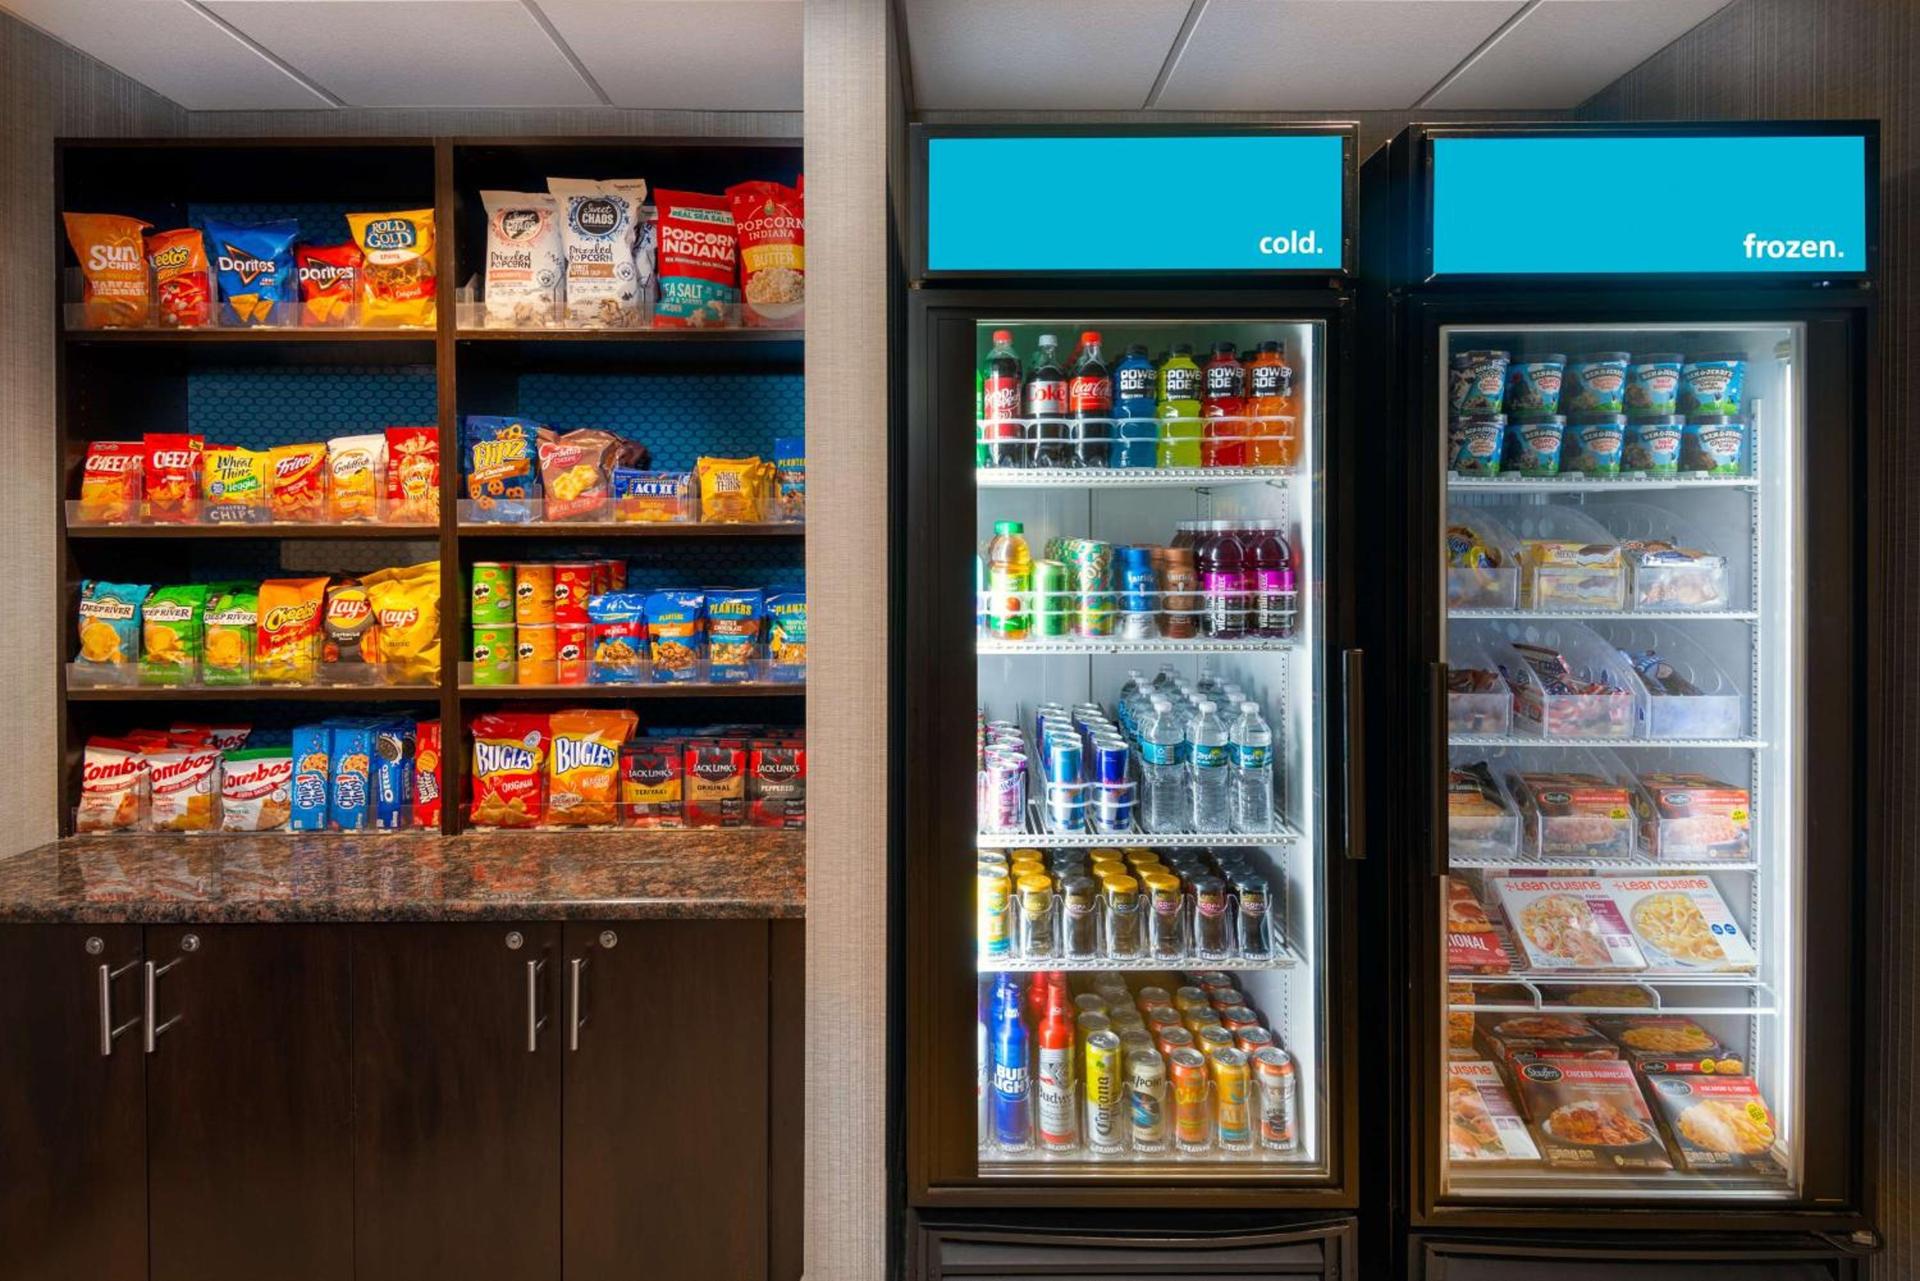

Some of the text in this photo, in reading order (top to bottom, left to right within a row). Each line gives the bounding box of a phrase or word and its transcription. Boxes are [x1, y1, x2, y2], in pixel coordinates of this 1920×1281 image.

[371, 219, 410, 234] ROLD
[582, 214, 614, 226] CHAOS
[736, 216, 804, 234] POPCORN
[366, 231, 413, 248] GOLD
[662, 226, 737, 247] POPCORN
[748, 228, 795, 241] INDIANA
[1259, 229, 1324, 255] cold.
[662, 238, 736, 263] INDIANA
[1743, 232, 1845, 259] frozen.
[88, 244, 140, 272] Sun
[218, 256, 276, 273] Doritos
[490, 260, 532, 269] POPCORN
[569, 253, 614, 263] POPCORN
[107, 261, 142, 271] CHIPS
[299, 266, 354, 281] Doritos
[676, 284, 703, 298] SALT
[1120, 369, 1157, 380] POWE
[1167, 370, 1201, 380] POWE
[1120, 379, 1145, 390] ADE
[1167, 379, 1192, 390] ADE
[1207, 377, 1232, 388] ADE
[1252, 377, 1276, 388] ADE
[275, 454, 313, 477] Fritos
[333, 456, 371, 474] Goldfish
[635, 482, 658, 495] ACT
[210, 509, 256, 520] CHIPS
[80, 602, 131, 616] DEEP RIVER
[160, 607, 189, 618] RIVER
[327, 599, 370, 619] Lay's
[709, 602, 752, 616] PLANTERS
[380, 608, 417, 628] Lay's
[475, 740, 536, 778] BUGLES
[555, 736, 617, 775] BUGLES
[82, 756, 151, 782] Combo
[151, 753, 216, 782] ombos
[629, 769, 648, 778] JACK
[693, 763, 712, 773] JACK
[757, 763, 776, 773] JACK
[382, 764, 394, 803] OREO
[697, 784, 731, 792] ORIGINAL
[296, 781, 314, 809] Chips
[336, 781, 353, 809] Chips
[996, 1065, 1027, 1081] BUD
[1450, 1064, 1493, 1076] uisine
[994, 1073, 1024, 1094] LIGH
[1095, 1075, 1113, 1137] Corona
